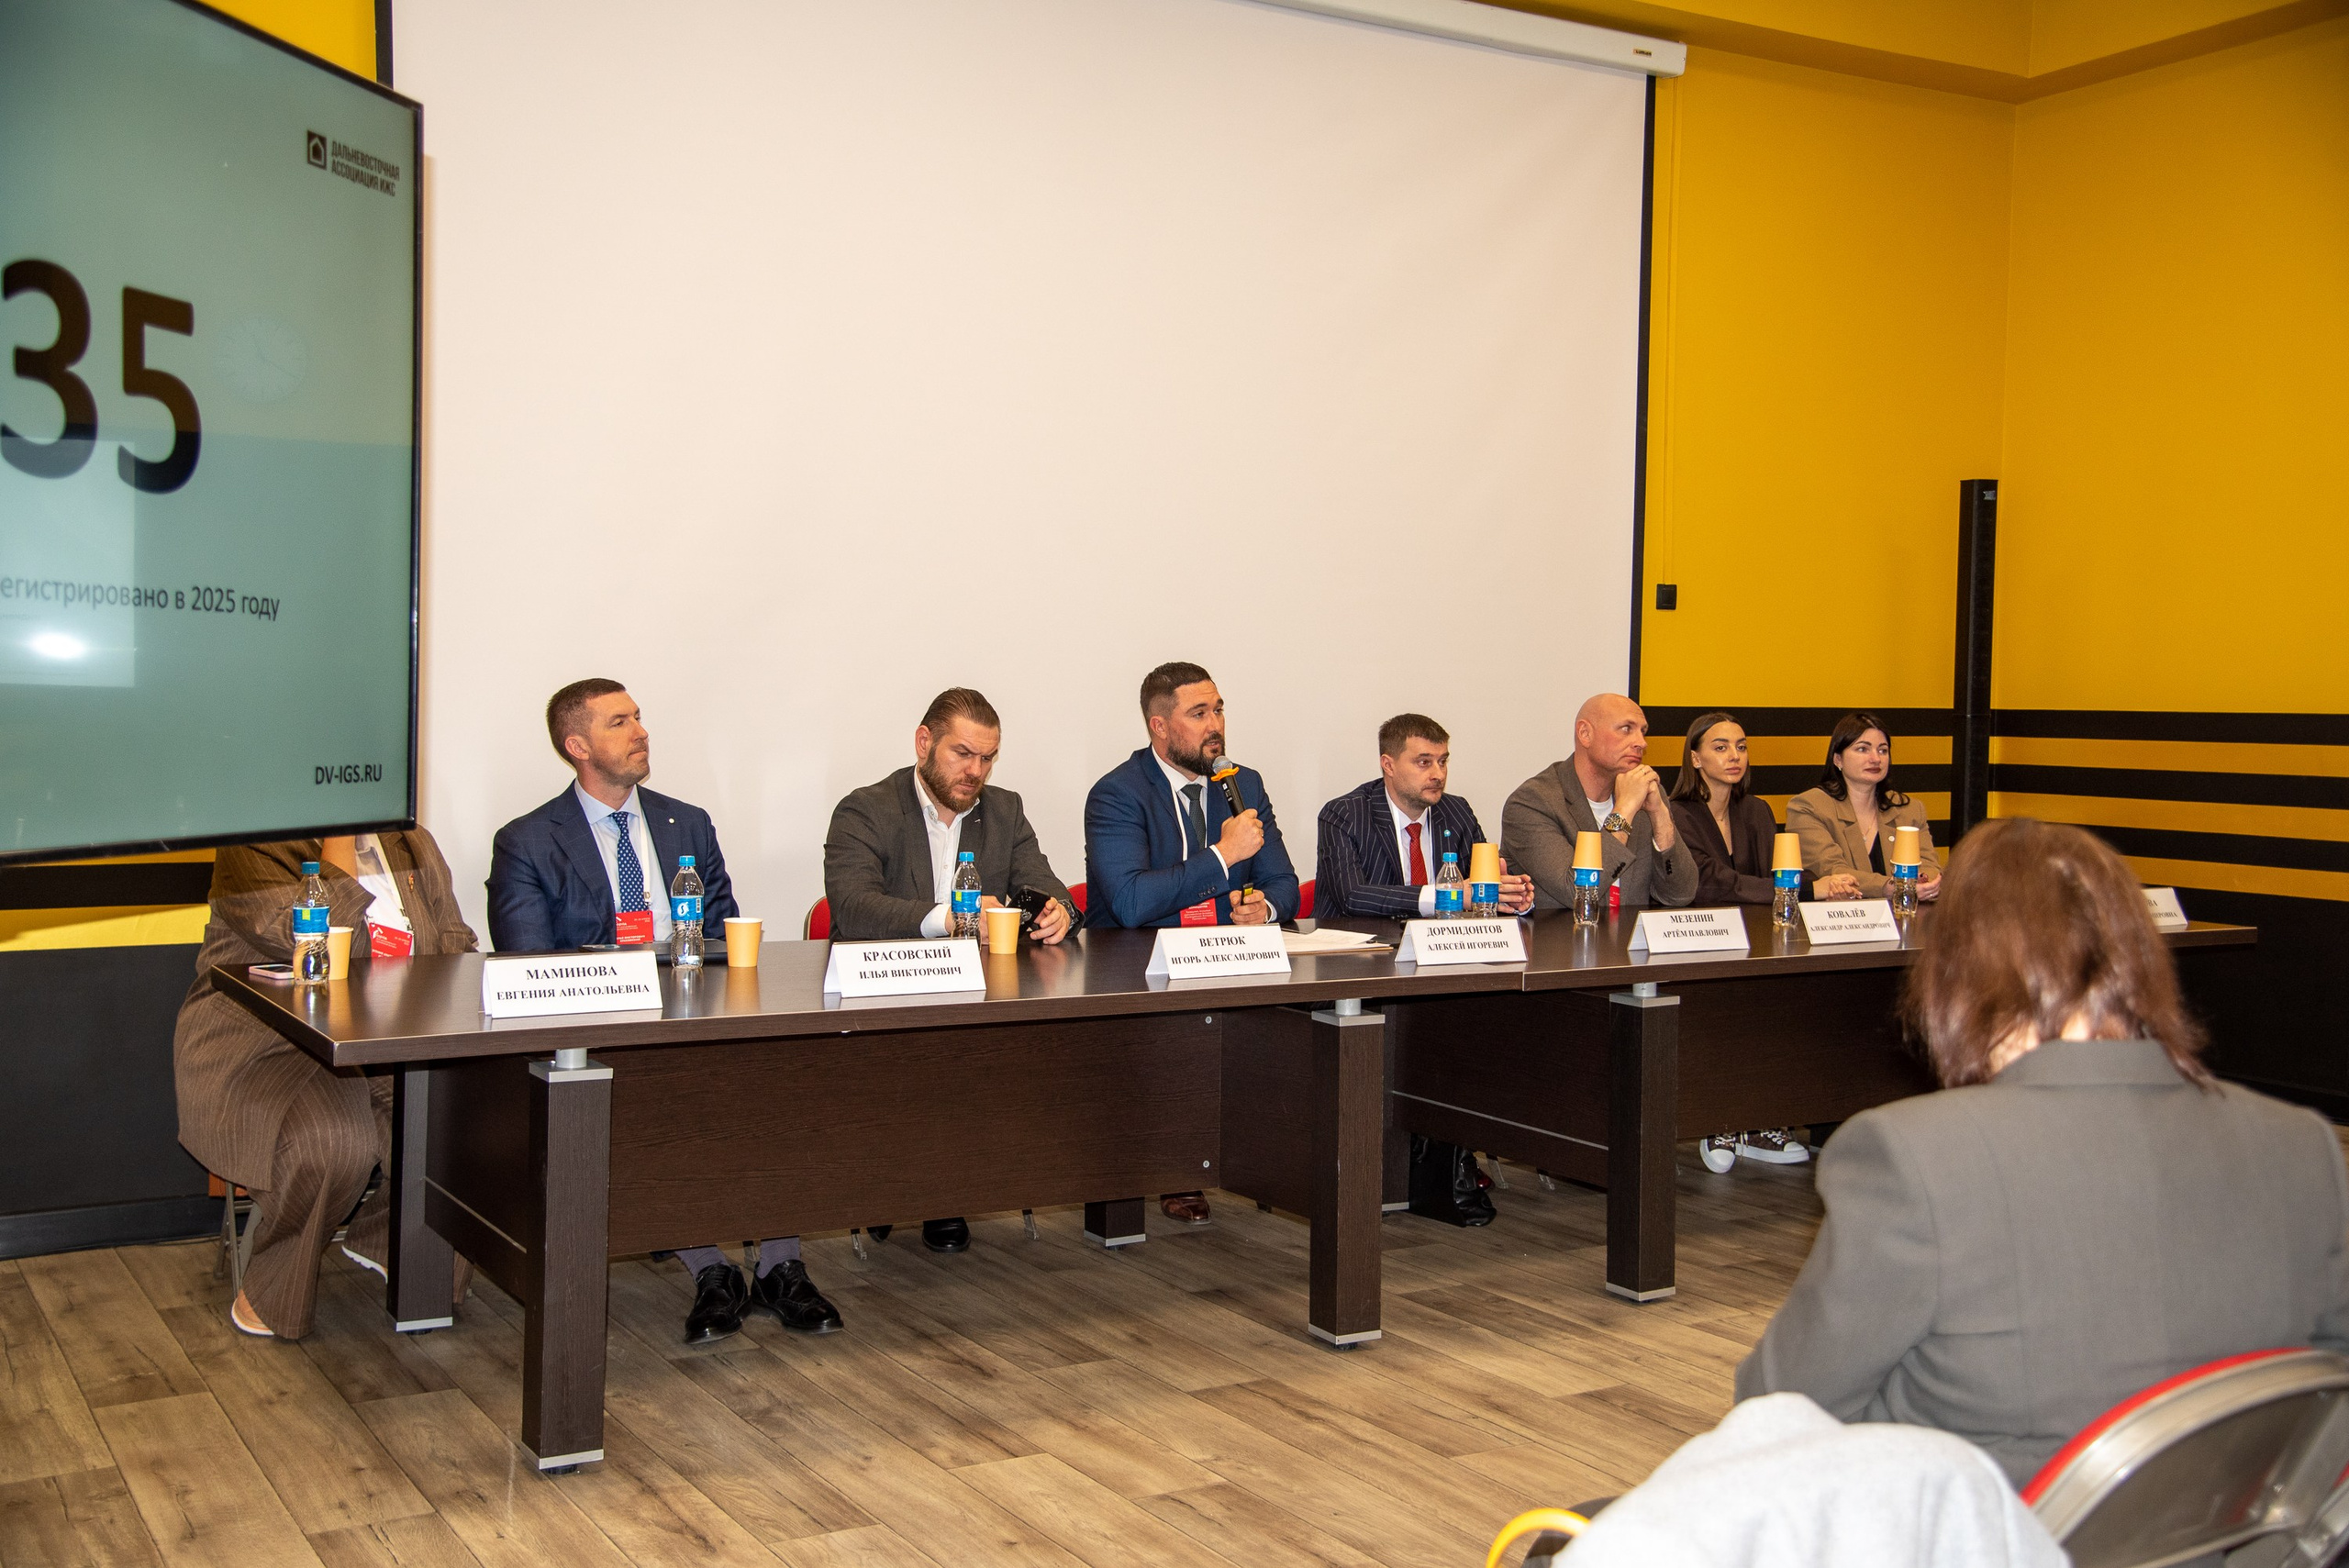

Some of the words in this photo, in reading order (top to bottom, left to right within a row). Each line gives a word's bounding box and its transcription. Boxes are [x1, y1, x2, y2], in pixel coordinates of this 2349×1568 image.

[331, 140, 400, 182] ДАЛЬНЕВОСТОЧНАЯ
[331, 159, 379, 190] АССОЦИАЦИЯ
[380, 177, 395, 197] ИЖС
[0, 258, 202, 495] 35
[0, 576, 169, 609] егистрировано
[174, 591, 185, 609] в
[191, 585, 236, 613] 2025
[241, 595, 280, 621] году
[316, 764, 382, 784] DV-IGS.RU
[1670, 914, 1714, 924] МЕЗЕНИН
[1827, 908, 1866, 919] КОВАЛЁВ
[1427, 925, 1502, 937] ДОРМИДОНТОВ
[1844, 922, 1890, 931] АЛЕКСАНДРОВИЧ
[1663, 929, 1687, 939] АРТЁМ
[1688, 929, 1729, 938] ПАВЛОВИЧ
[1199, 936, 1246, 948] ВЕТРЮК
[1428, 941, 1465, 951] АЛЕКСЕЙ
[1467, 940, 1509, 950] ИГОРЕВИЧ
[863, 946, 952, 962] КРАСОВСКИЙ
[1171, 955, 1202, 965] ИГОРЬ
[1203, 951, 1281, 963] АЛЕКСАНДРОВИЧ
[526, 965, 618, 981] МАМИНОВА
[859, 970, 888, 980] ИЛЬЯ
[891, 966, 962, 978] ВИКТОРОВИЧ
[496, 988, 556, 1001] ЕВГЕНИЯ
[559, 984, 650, 998] АНАТОЛЬЕВНА
